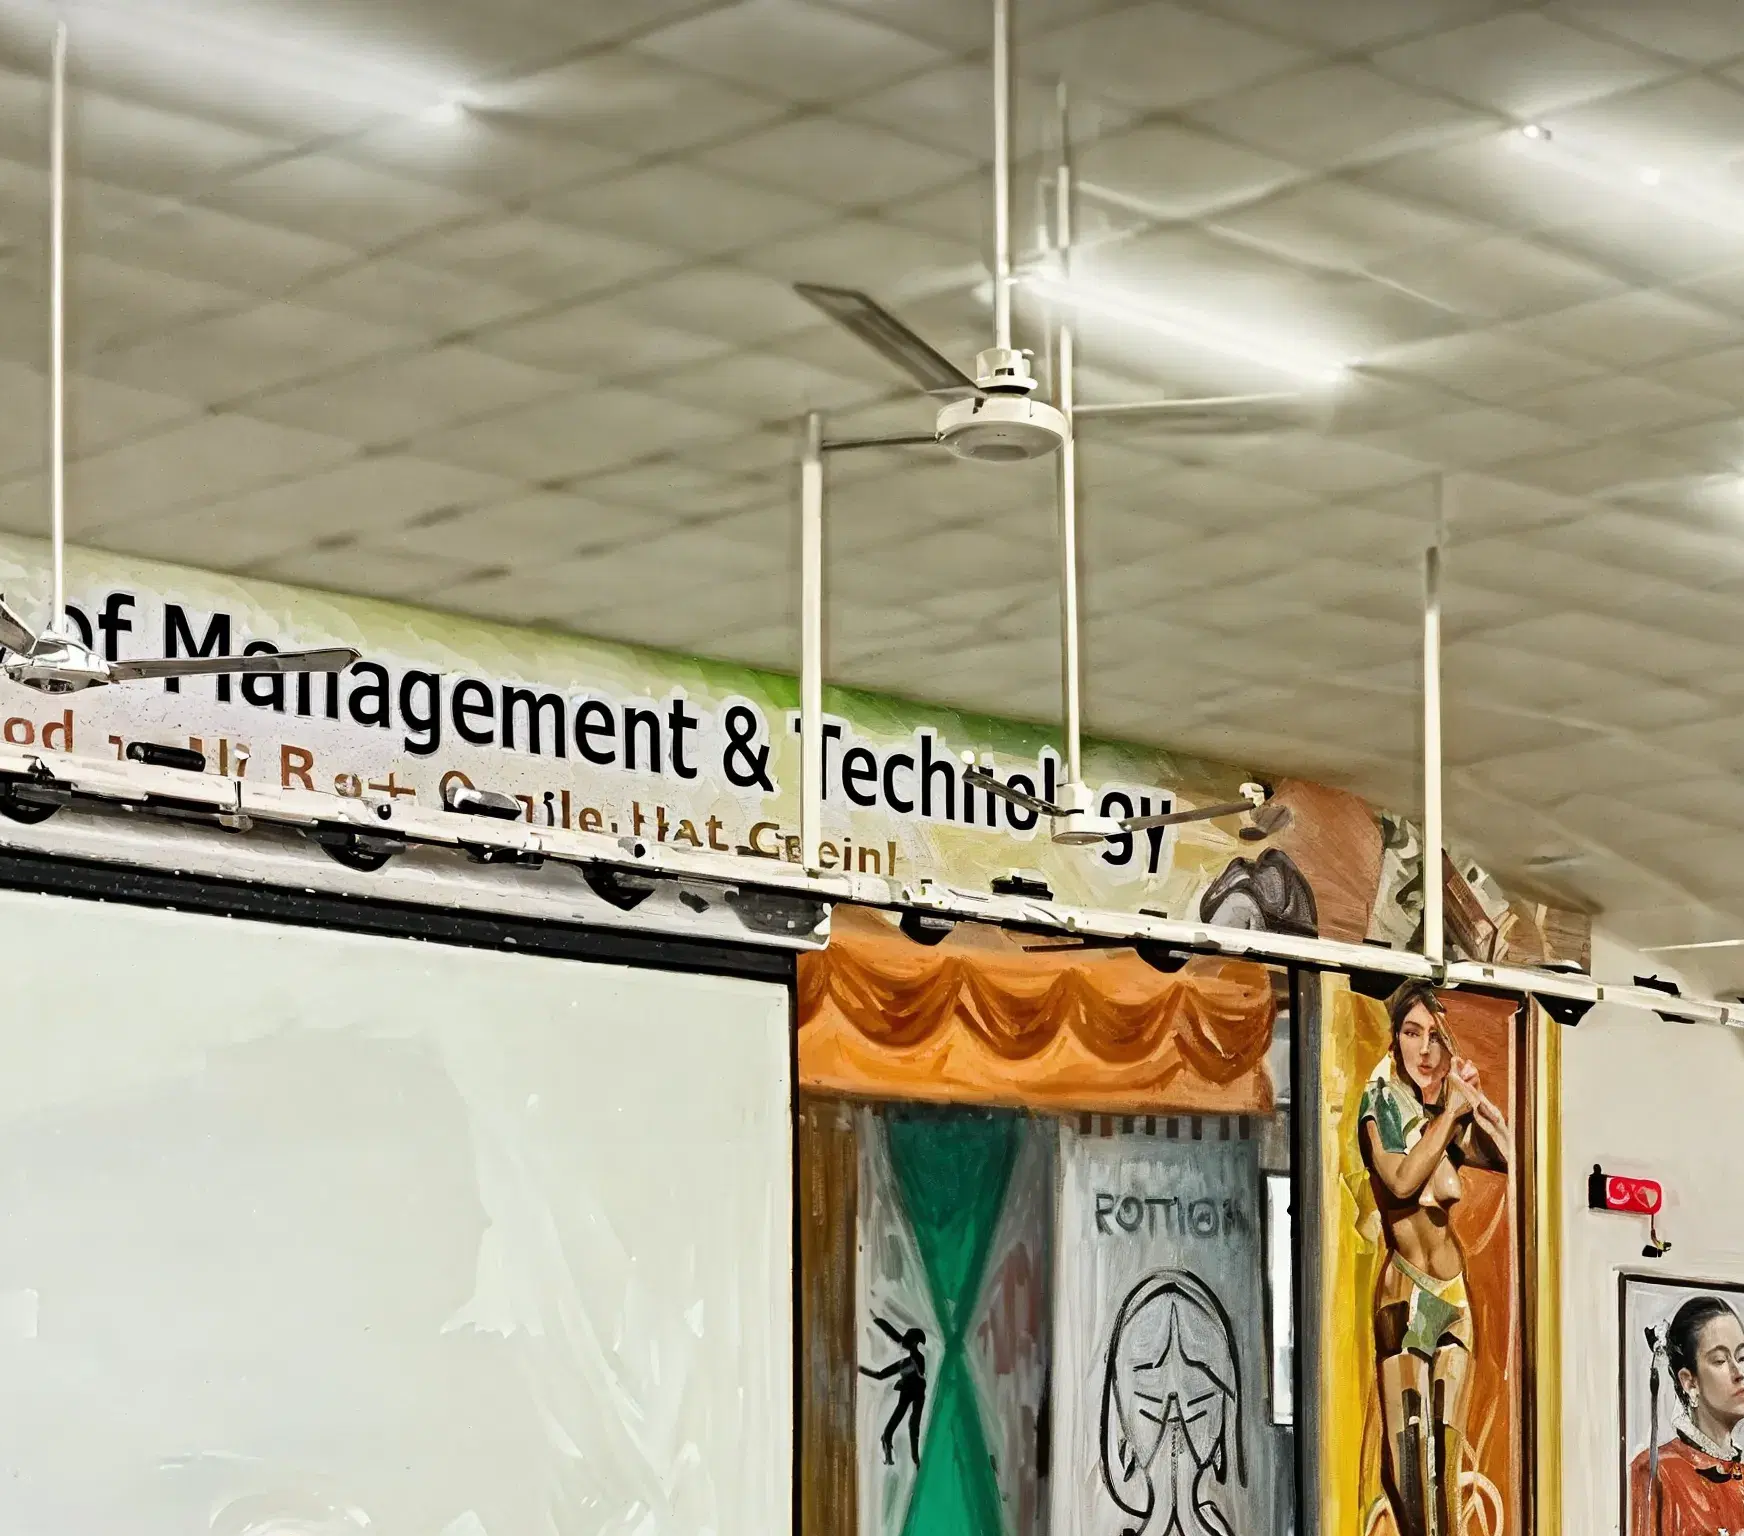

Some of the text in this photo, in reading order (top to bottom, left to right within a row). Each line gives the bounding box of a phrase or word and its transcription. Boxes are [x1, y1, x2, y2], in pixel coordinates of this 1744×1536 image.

[164, 602, 698, 779] Management
[723, 705, 774, 792] &
[794, 717, 1172, 874] Technolgy
